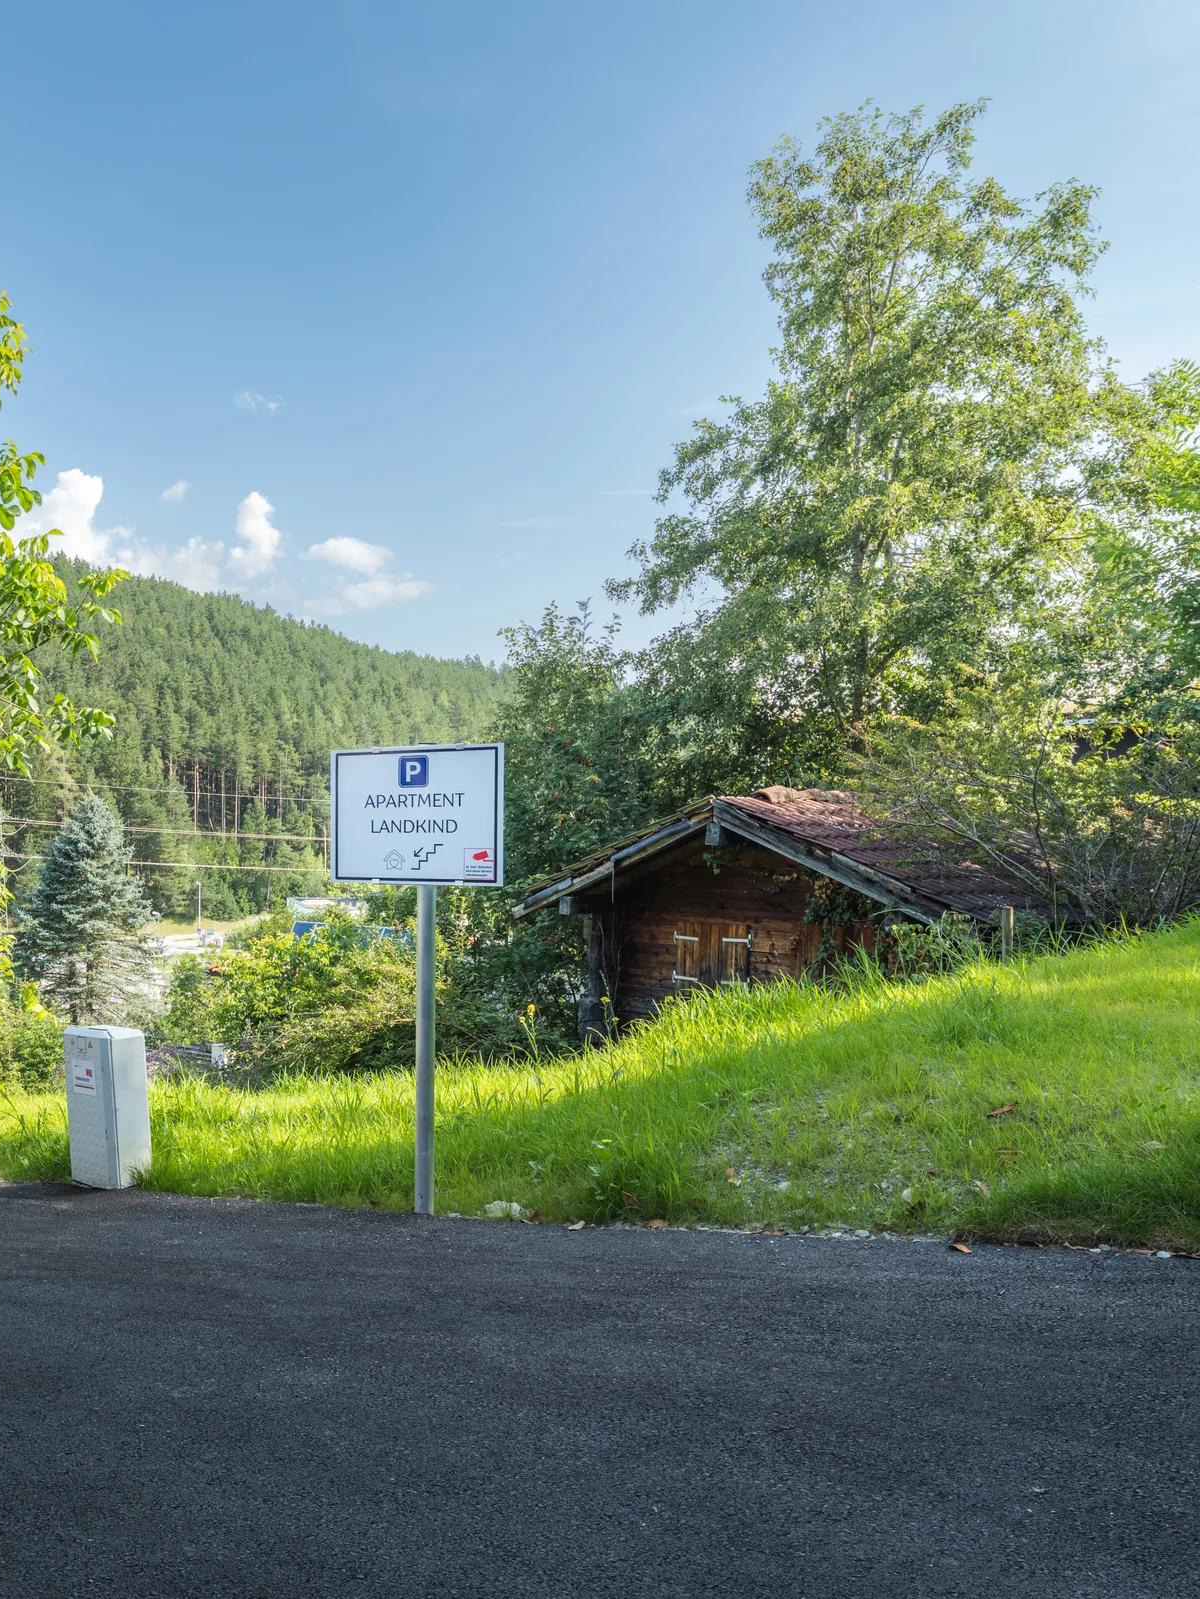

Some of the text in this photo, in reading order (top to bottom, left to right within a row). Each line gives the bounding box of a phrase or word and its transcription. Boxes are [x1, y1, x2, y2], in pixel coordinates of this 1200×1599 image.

[405, 761, 421, 782] P
[364, 793, 465, 808] APARTMENT
[371, 819, 458, 834] LANDKIND
